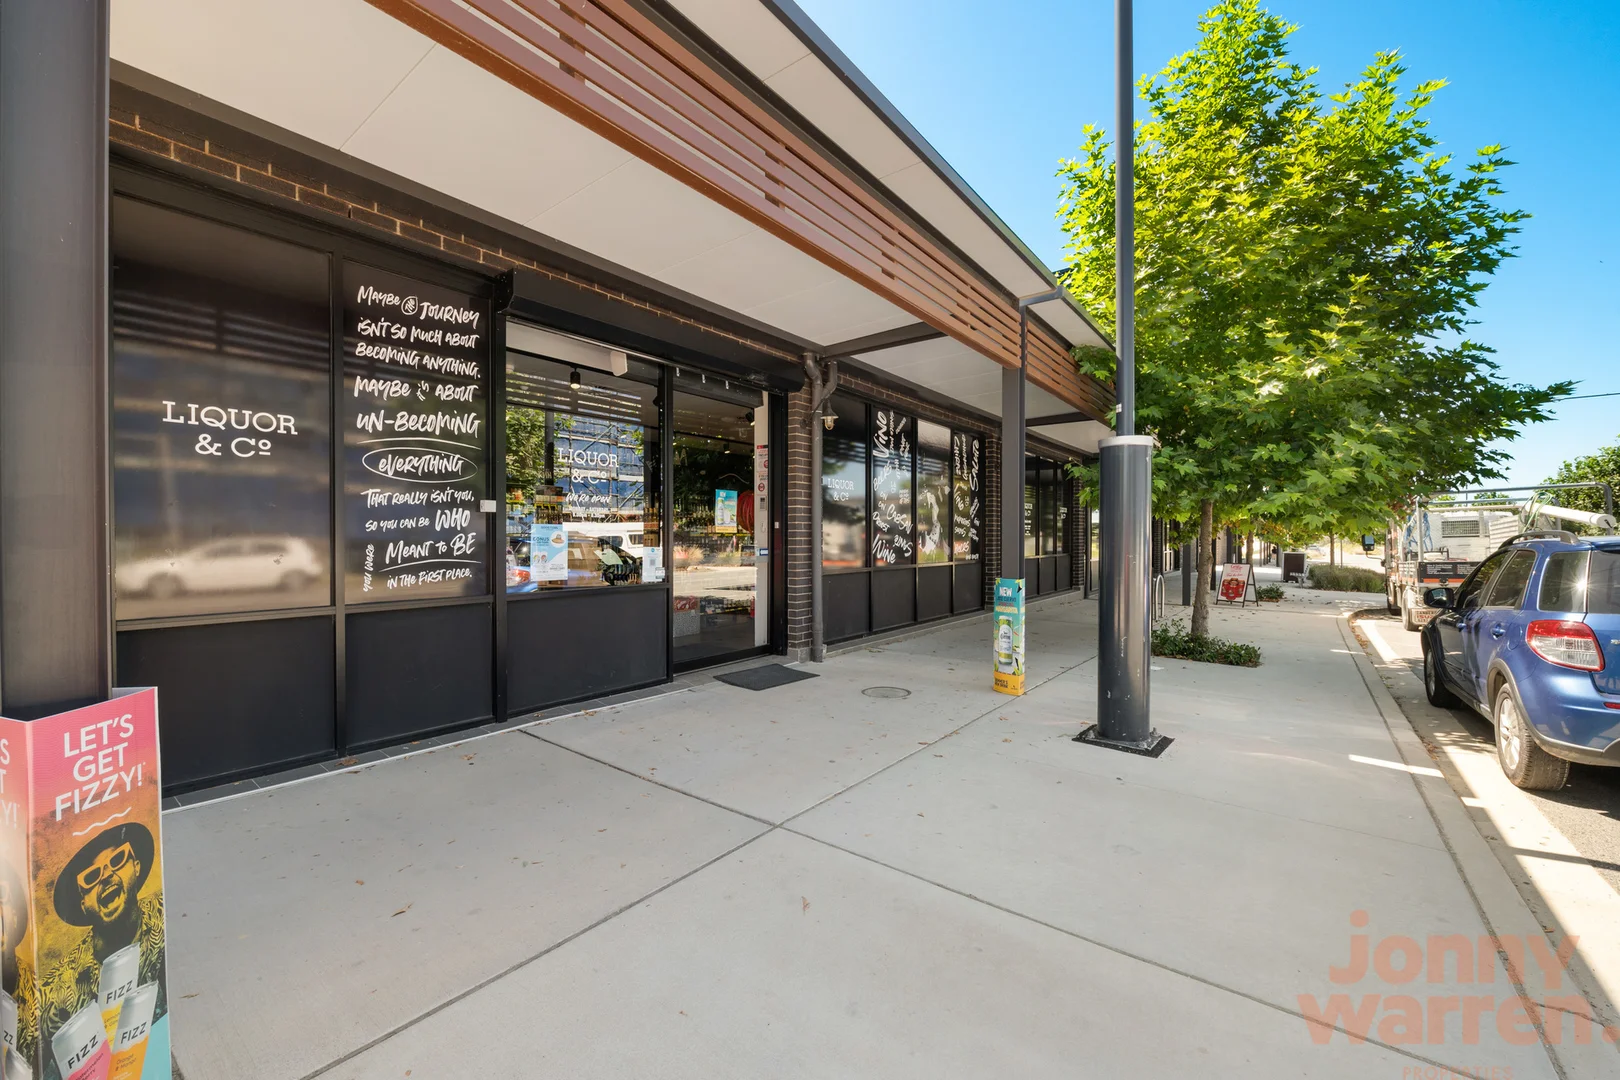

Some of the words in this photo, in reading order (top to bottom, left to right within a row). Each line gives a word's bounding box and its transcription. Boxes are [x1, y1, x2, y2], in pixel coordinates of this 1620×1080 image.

[163, 400, 298, 435] LIQUOR
[195, 433, 222, 456] &
[557, 447, 619, 468] LIQUOR
[571, 468, 584, 483] &
[828, 478, 854, 491] LIQUOR
[434, 508, 470, 531] WHO
[450, 532, 477, 556] BE
[999, 587, 1012, 597] NEW
[64, 713, 134, 758] LET'S
[73, 741, 129, 782] GET
[55, 764, 142, 821] FIZZY!
[105, 980, 133, 1004] FIZZ
[120, 1022, 147, 1044] FIZZ
[67, 1034, 99, 1069] FIZZ
